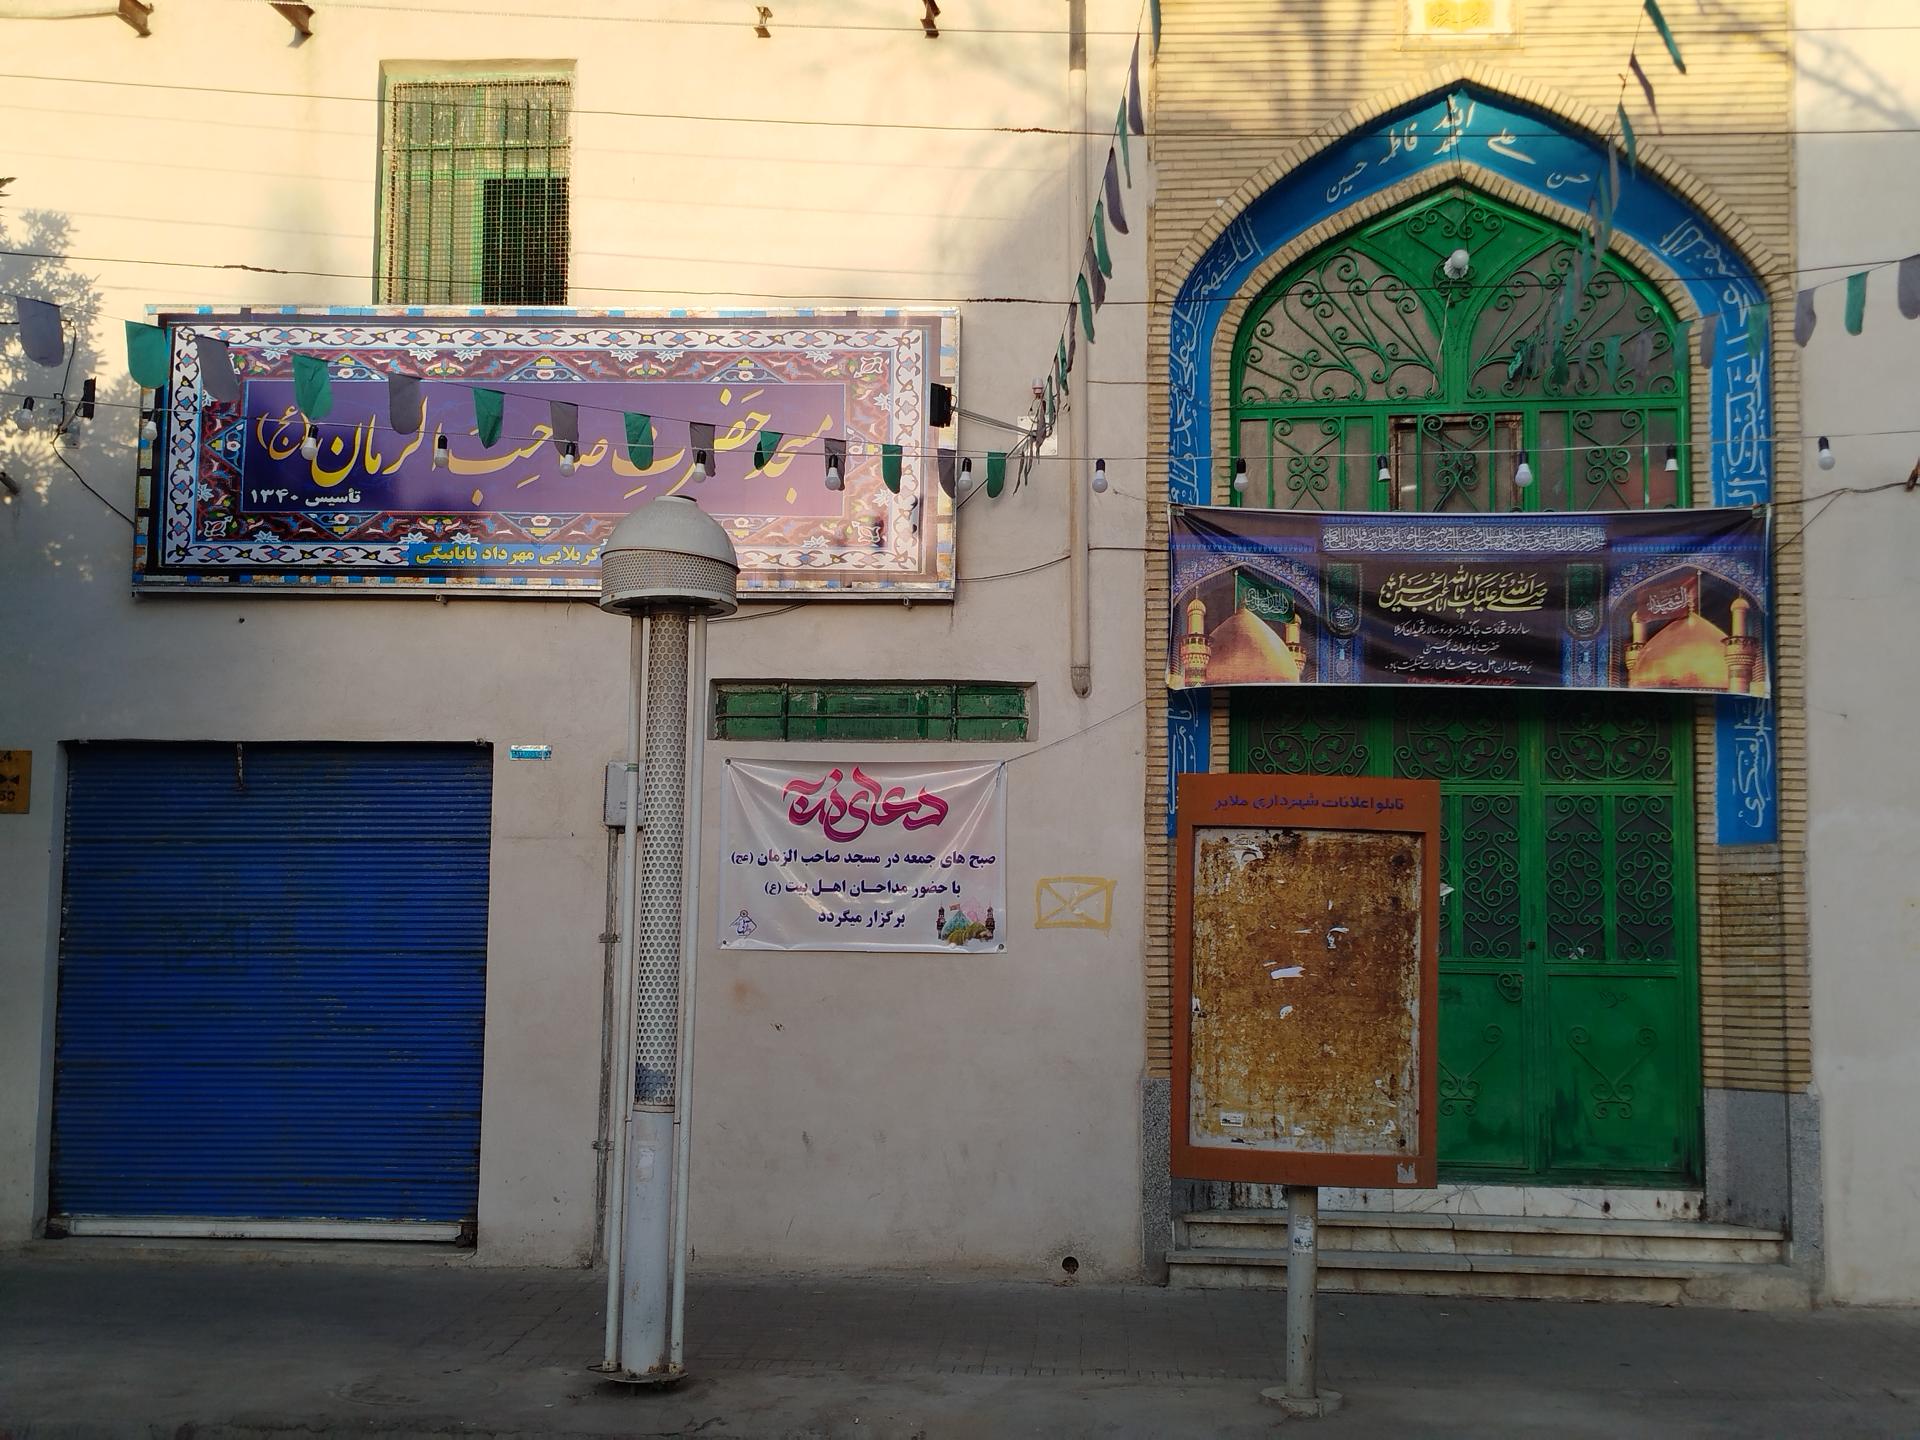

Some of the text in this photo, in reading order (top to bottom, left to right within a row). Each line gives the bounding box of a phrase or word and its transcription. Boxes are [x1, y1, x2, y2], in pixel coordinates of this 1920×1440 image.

[1327, 161, 1369, 203] حسین
[1546, 170, 1591, 190] حسن
[416, 545, 478, 565] بابابیگی
[1213, 794, 1249, 811] ملایر
[731, 848, 996, 869] صبح های جمعه در مسجد صاحب الزمان (عج)
[764, 881, 782, 897] (ع)
[785, 880, 809, 897] بیت
[812, 879, 846, 897] اهل
[911, 882, 948, 900] حضور
[951, 882, 961, 898] با
[817, 908, 906, 929] برگزار میگردد
